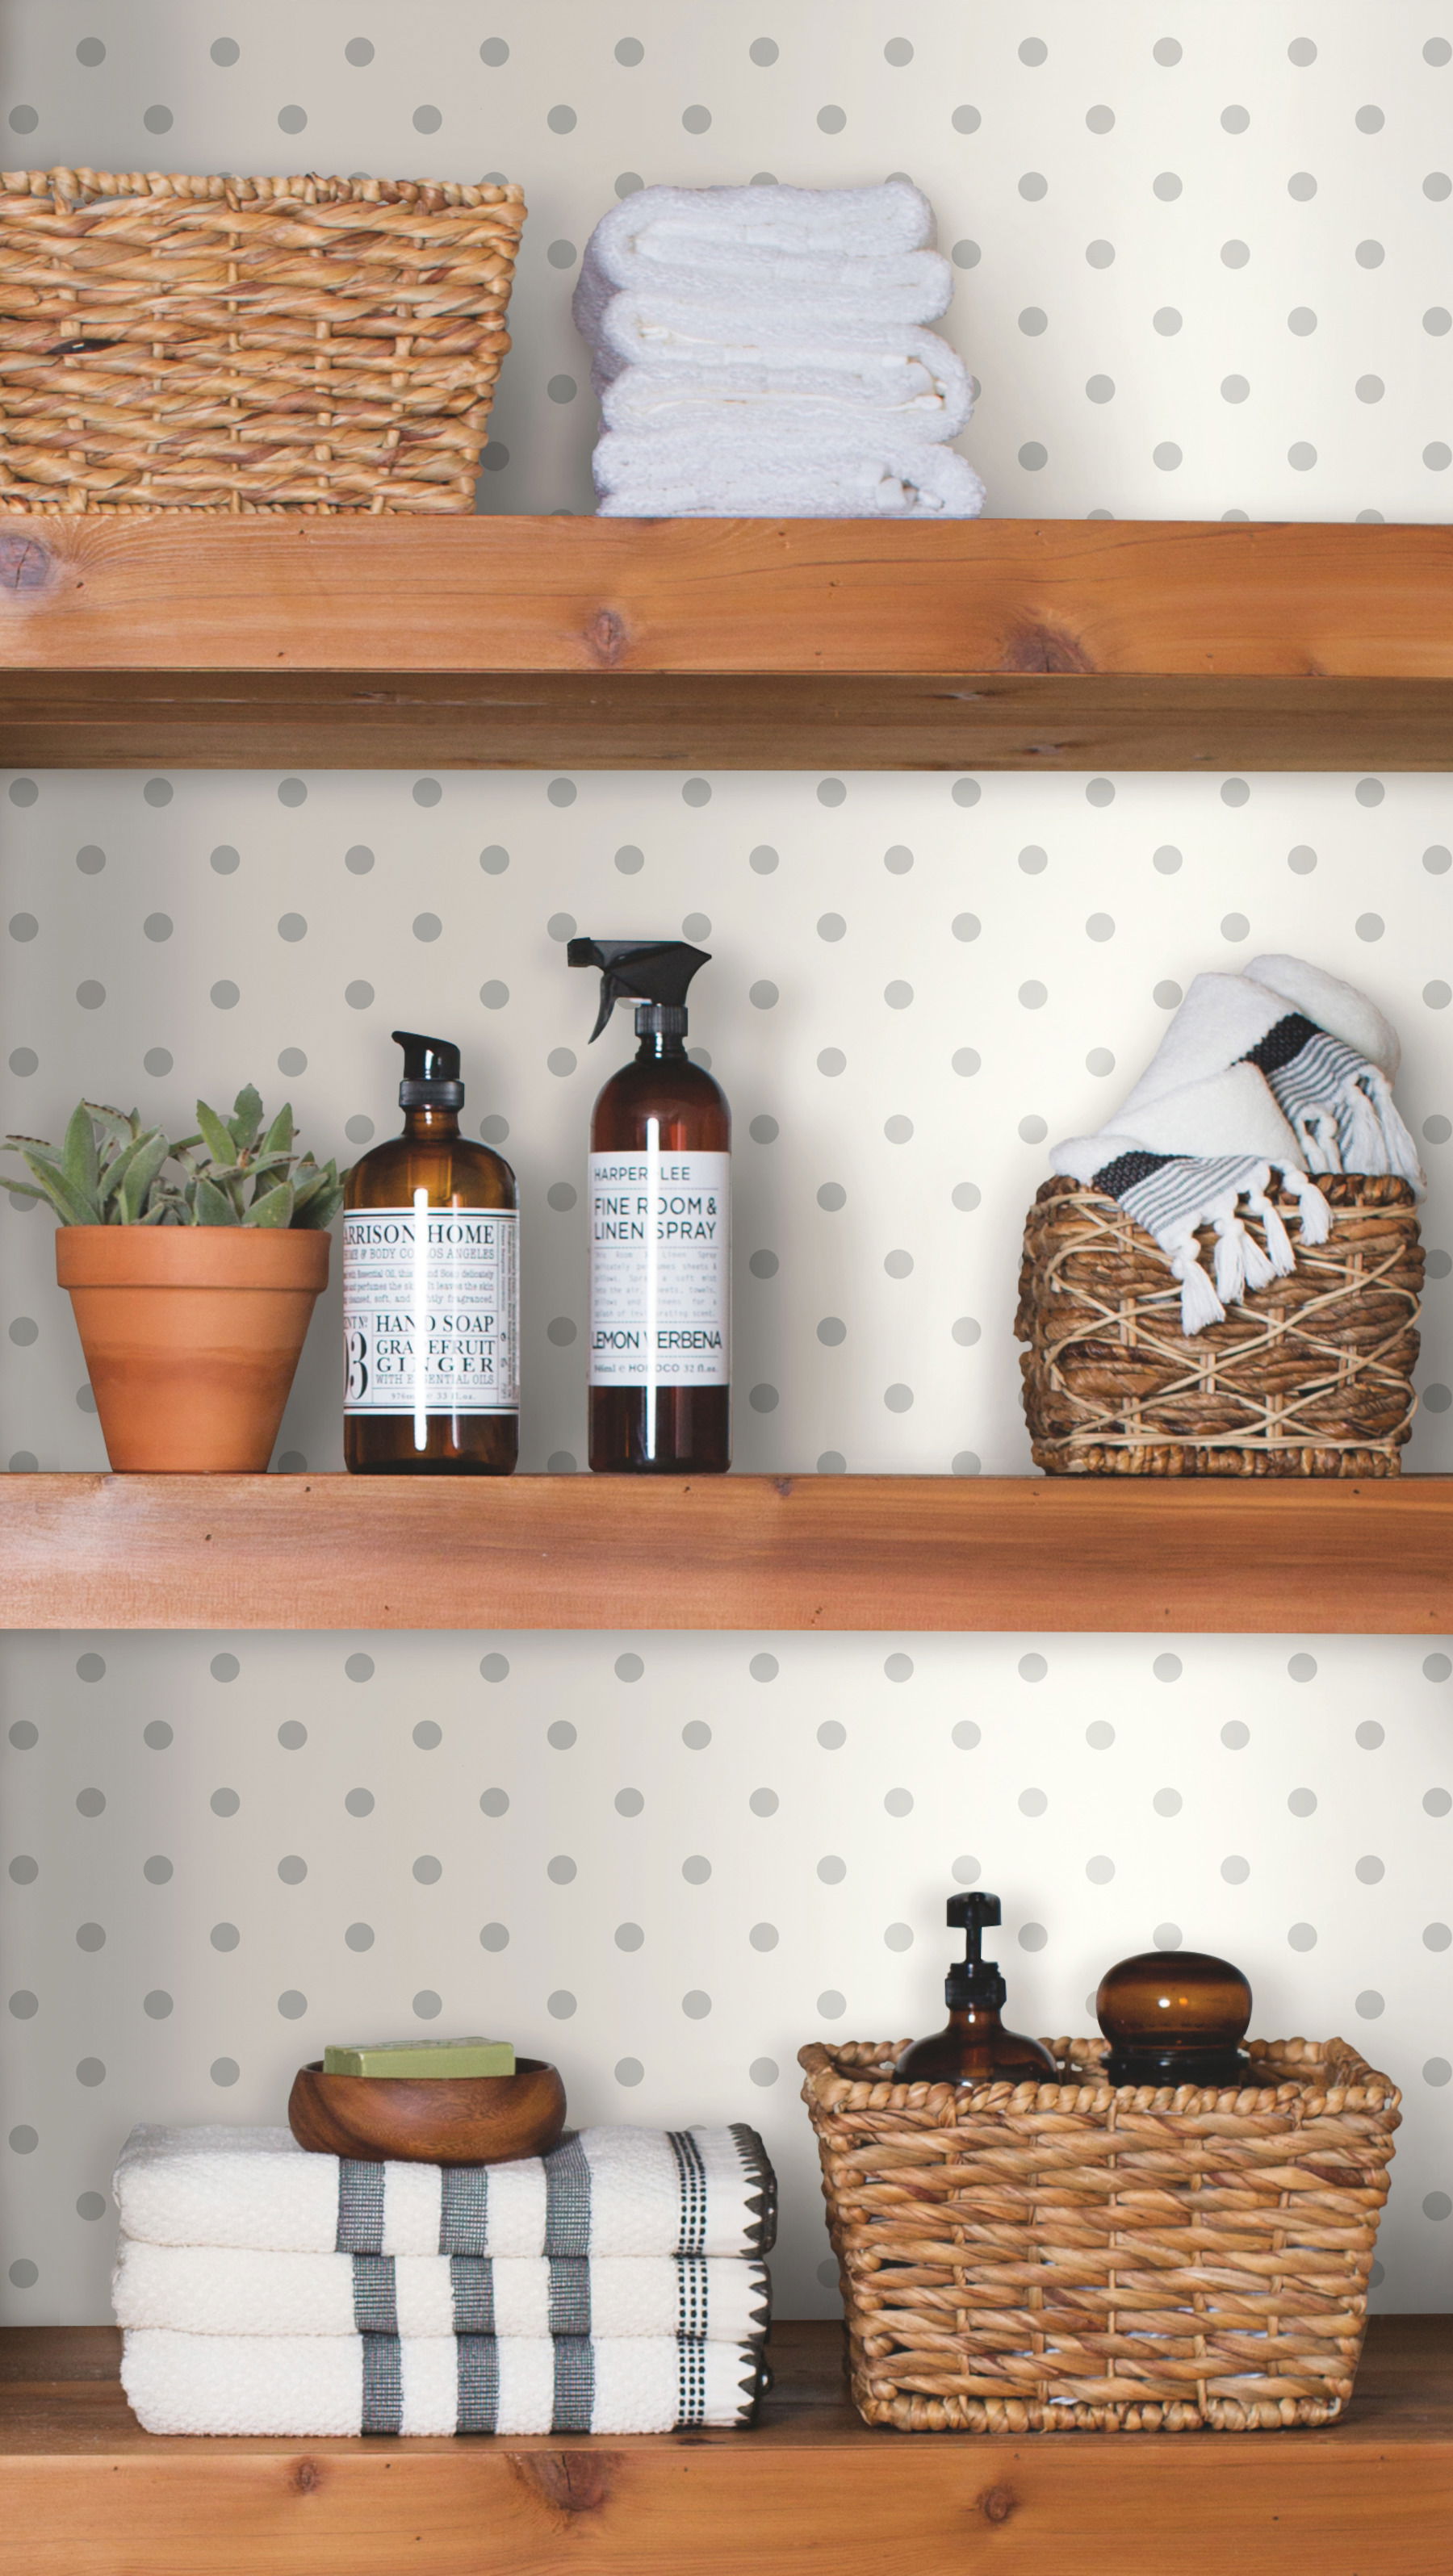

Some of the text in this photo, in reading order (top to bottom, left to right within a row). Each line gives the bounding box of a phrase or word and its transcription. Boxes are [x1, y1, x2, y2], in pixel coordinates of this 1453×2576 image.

[593, 1166, 691, 1181] HARPER LEE
[594, 1196, 718, 1216] FINE ROOM &
[343, 1223, 494, 1245] ARRISON HOME
[594, 1221, 717, 1240] LINEN SPRAY
[369, 1248, 396, 1259] BODY
[428, 1248, 444, 1259] OS
[446, 1248, 495, 1260] ANGELES
[375, 1315, 495, 1332] HAND SOAP
[376, 1339, 496, 1355] GRAEFRUIT
[592, 1331, 639, 1349] LEMON
[628, 1362, 680, 1373] HOOCO
[375, 1374, 495, 1386] WITH EENTIAL OILS
